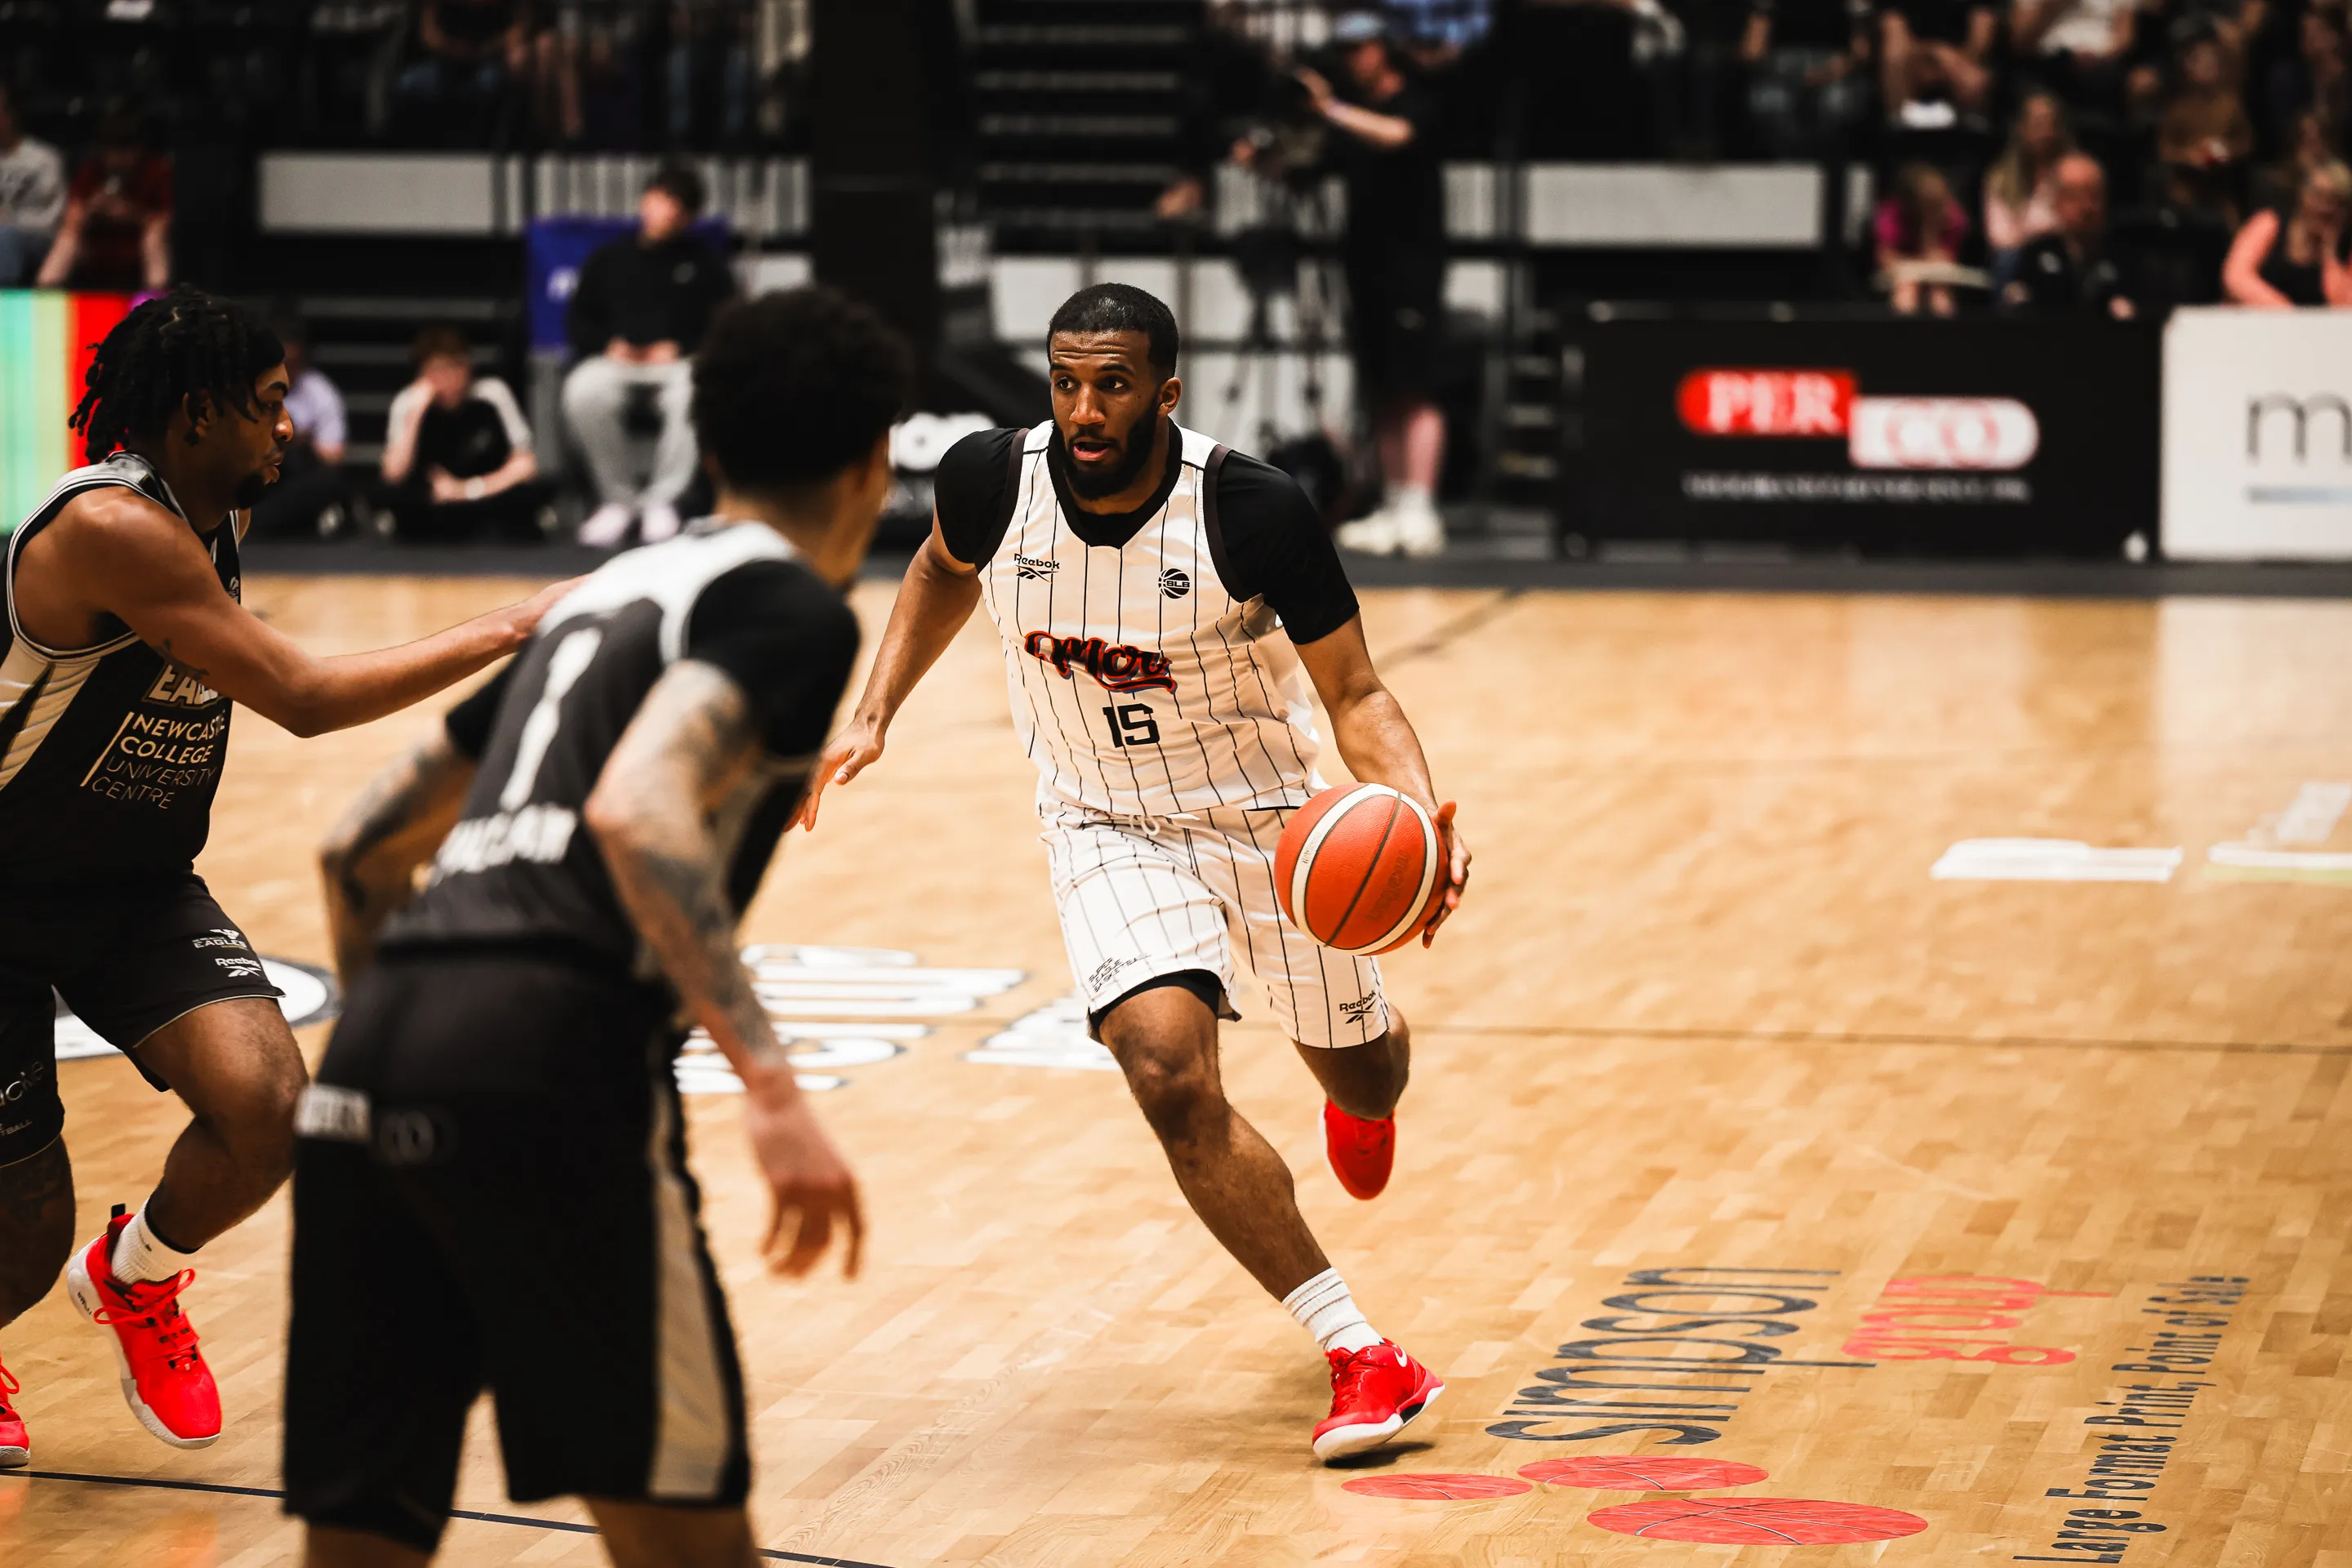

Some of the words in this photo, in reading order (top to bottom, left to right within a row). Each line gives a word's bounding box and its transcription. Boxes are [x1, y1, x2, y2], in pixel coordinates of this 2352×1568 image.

[1013, 553, 1060, 569] Reebok
[1102, 703, 1160, 748] 15
[106, 755, 217, 786] UNIVERSITY
[120, 736, 214, 764] COLLEGE
[91, 776, 175, 809] CENTRE
[1339, 990, 1376, 1012] Reebok
[1841, 1275, 2113, 1365] group
[2111, 1332, 2222, 1374] Point
[2083, 1382, 2218, 1428] Print,
[2044, 1434, 2177, 1501] Format
[2012, 1509, 2167, 1564] Large
